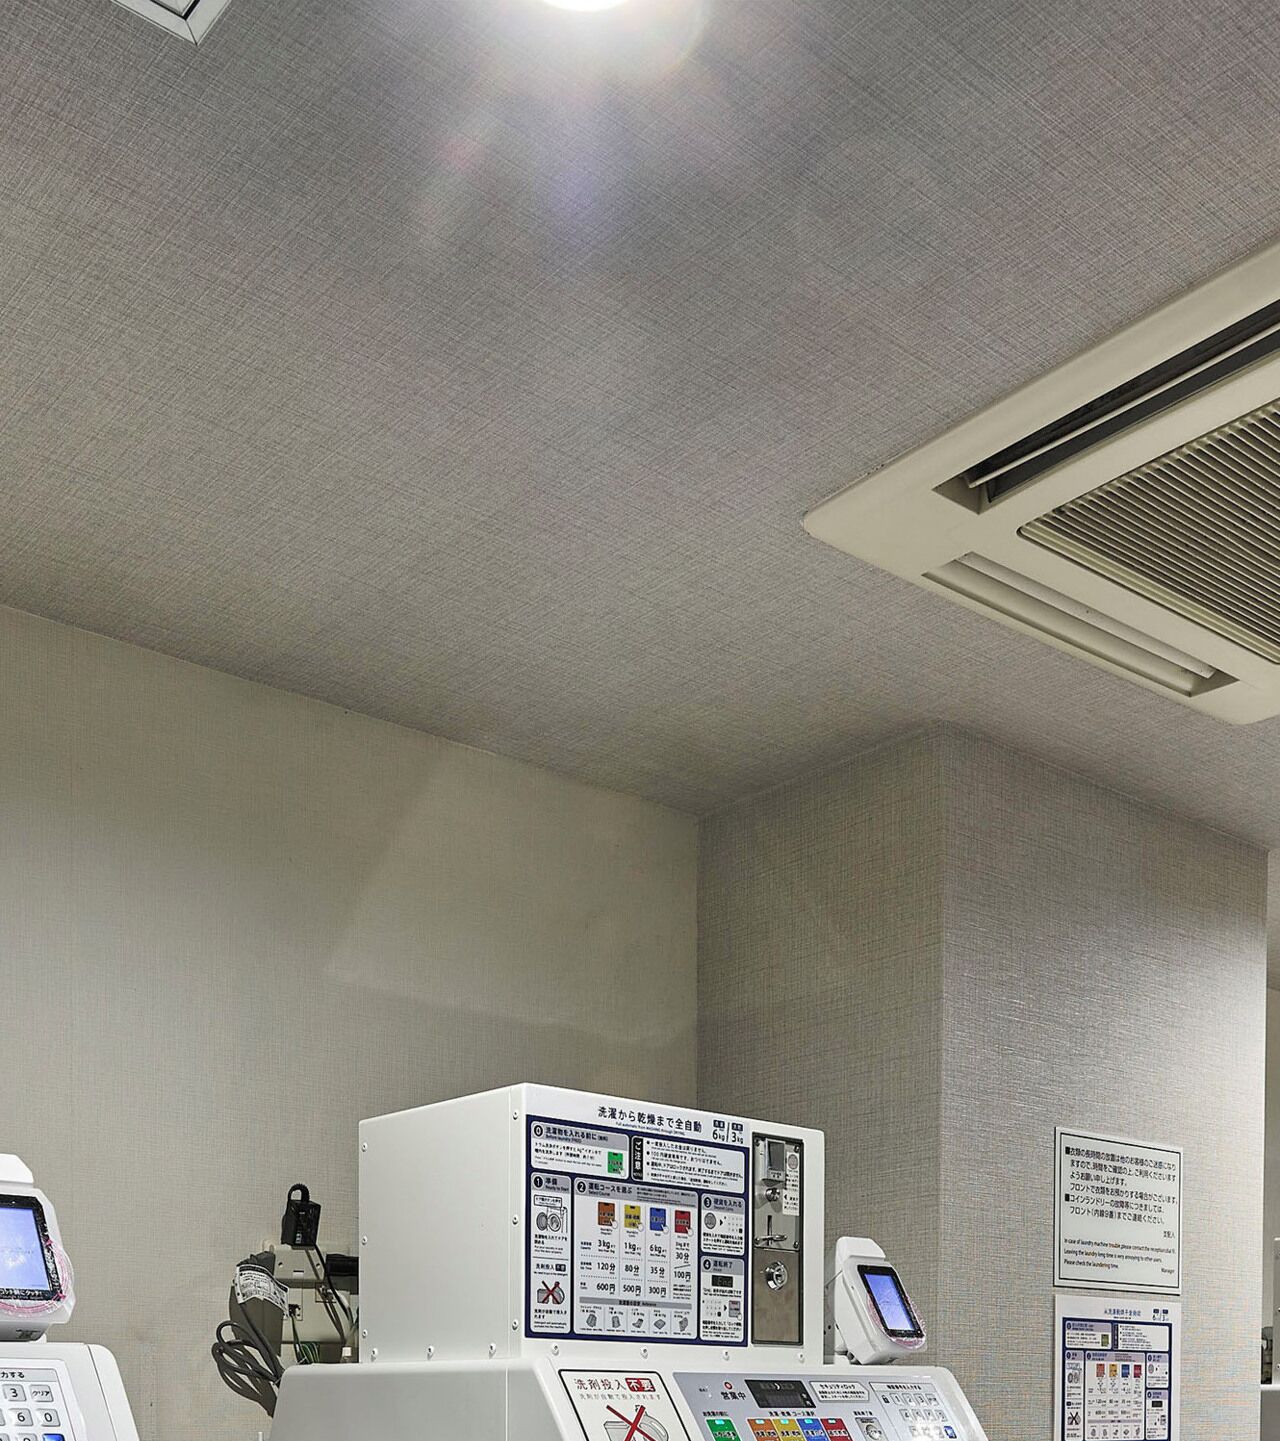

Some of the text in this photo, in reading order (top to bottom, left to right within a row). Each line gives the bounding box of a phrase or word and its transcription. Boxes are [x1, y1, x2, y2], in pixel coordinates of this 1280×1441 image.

[597, 1106, 703, 1133] 洗濯から乾燥まで全自動
[578, 1182, 584, 1192] 2
[574, 1378, 655, 1392] 洗剤投入 不要
[11, 1388, 19, 1398] 3
[721, 1391, 747, 1401] 営業中
[17, 1412, 26, 1422] 6
[44, 1412, 53, 1423] 0
